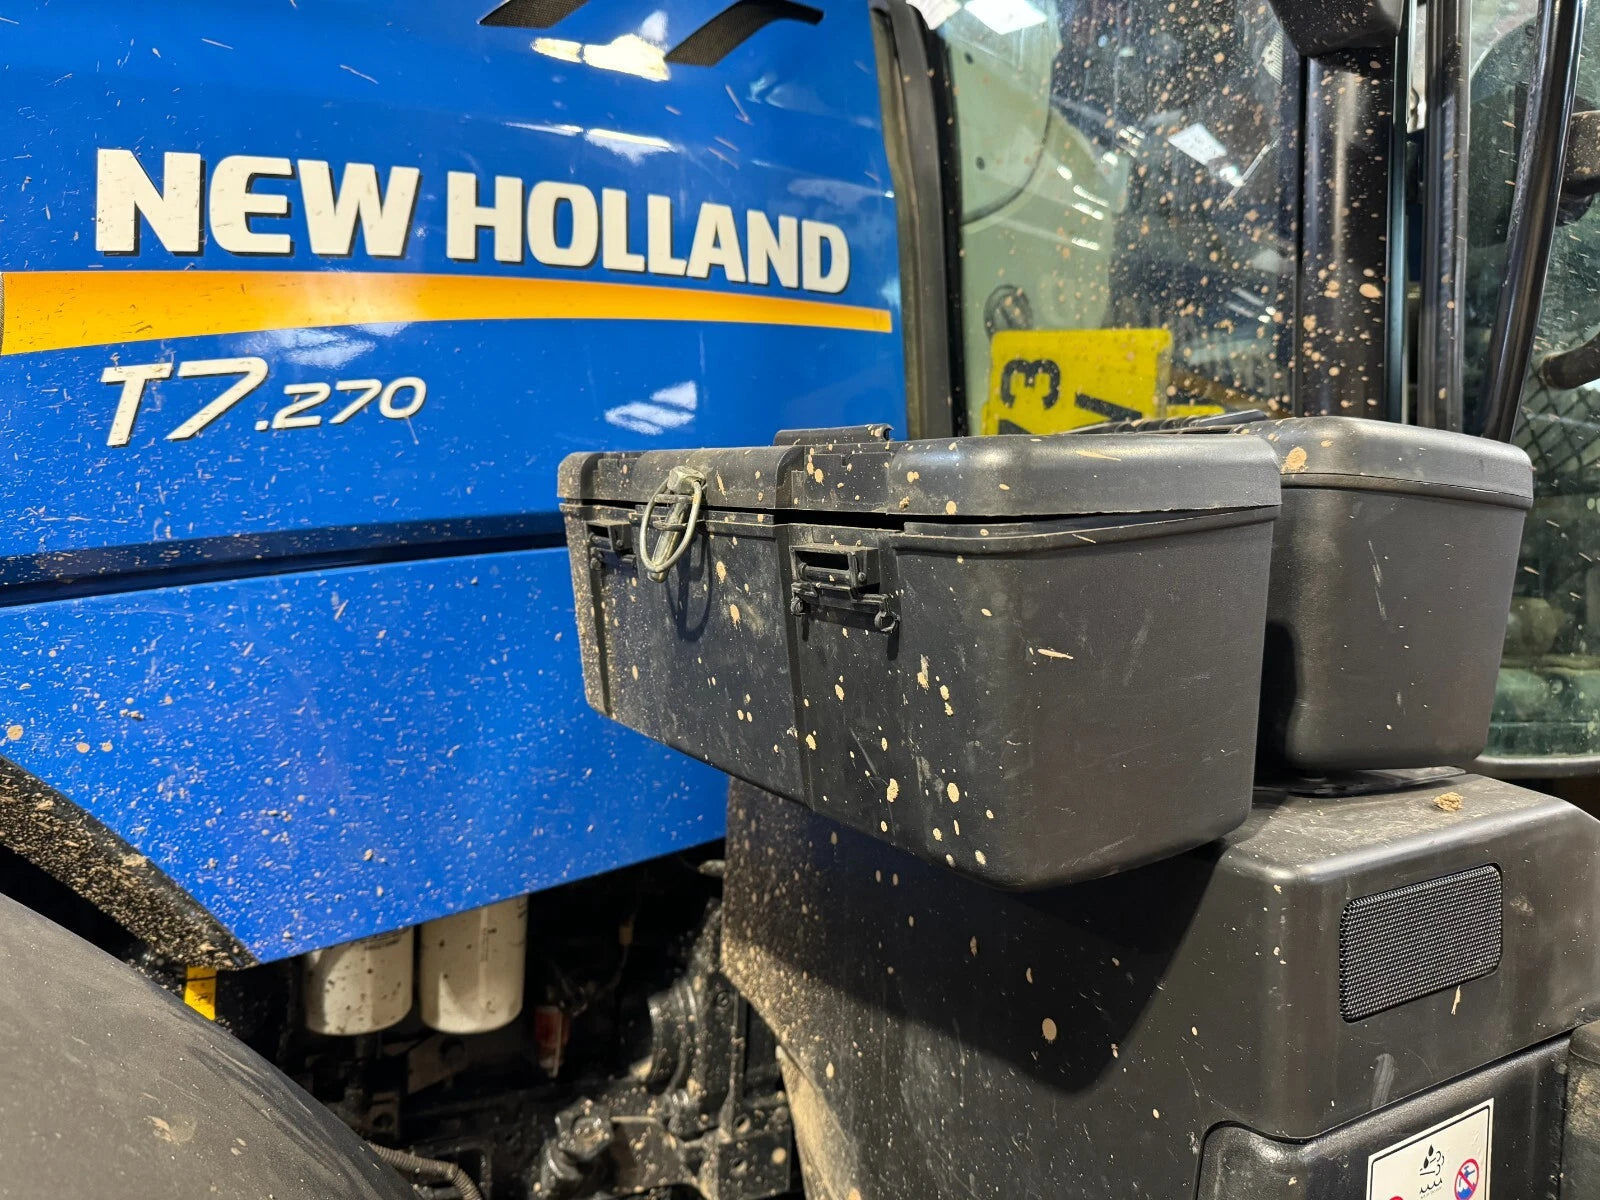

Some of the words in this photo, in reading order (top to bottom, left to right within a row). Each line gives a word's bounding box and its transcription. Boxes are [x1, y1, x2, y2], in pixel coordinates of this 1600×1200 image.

[95, 148, 420, 257] NEW
[446, 170, 850, 294] HOLLAND
[100, 356, 427, 447] T7.270
